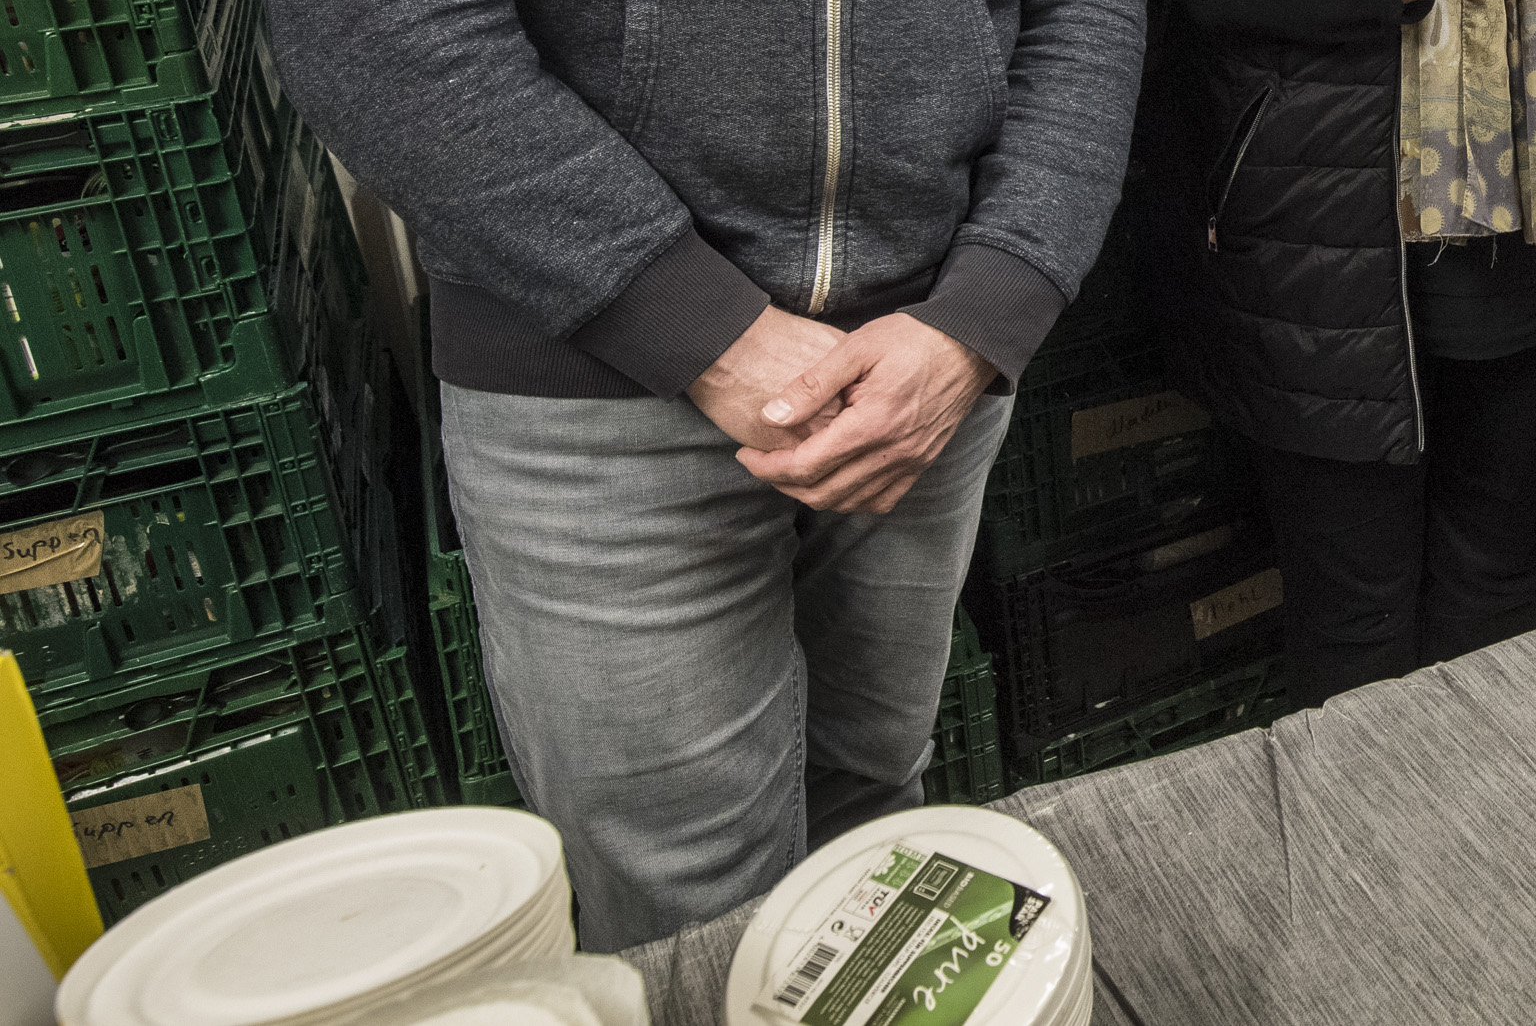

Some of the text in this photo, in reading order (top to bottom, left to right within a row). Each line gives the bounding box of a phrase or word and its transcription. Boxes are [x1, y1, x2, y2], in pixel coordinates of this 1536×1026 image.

[868, 890, 890, 916] TÜV
[913, 914, 986, 1012] pure
[985, 938, 1012, 967] 50
